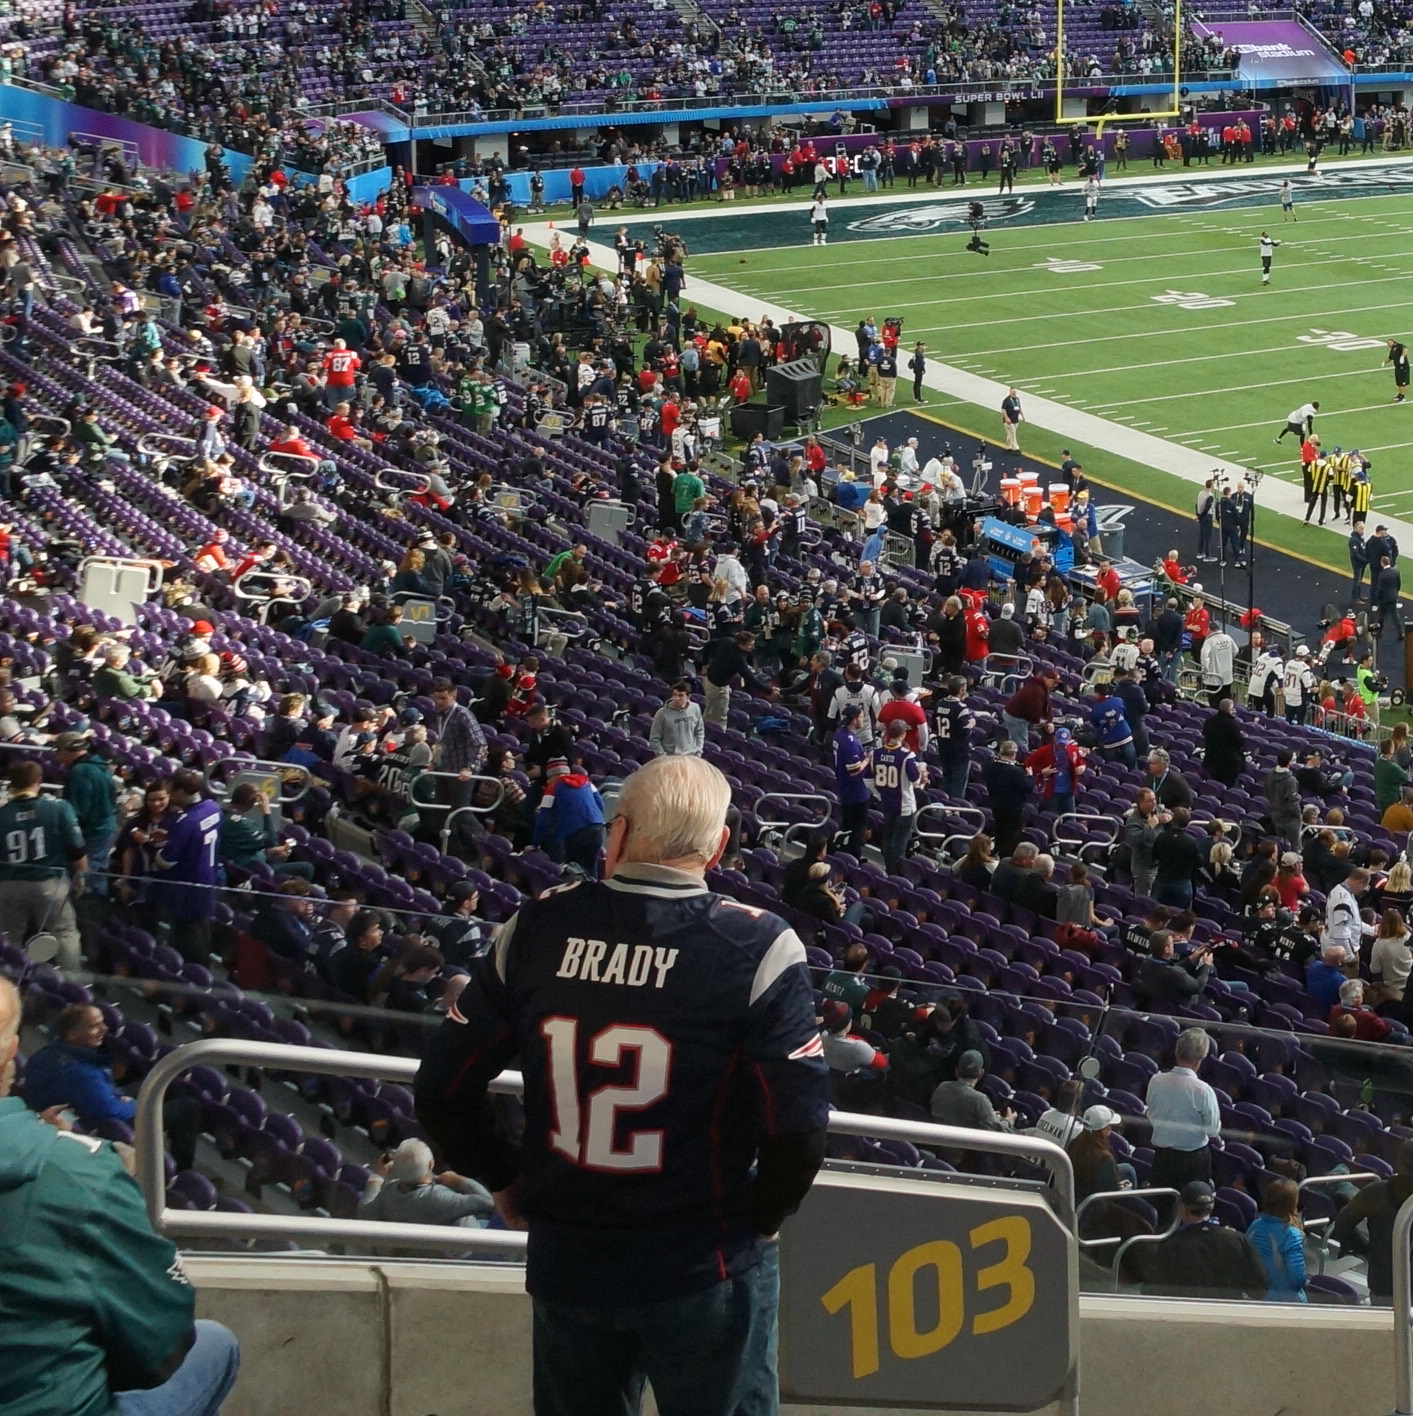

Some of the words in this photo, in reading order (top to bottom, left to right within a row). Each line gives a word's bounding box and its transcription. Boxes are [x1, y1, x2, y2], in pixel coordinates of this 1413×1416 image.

[1258, 49, 1315, 57] stadium
[332, 357, 351, 372] 87
[591, 414, 606, 427] 87
[939, 562, 952, 576] 12
[851, 650, 869, 670] 12
[936, 718, 950, 738] 12
[875, 765, 898, 788] 80
[6, 826, 48, 864] 91
[203, 830, 219, 868] 7
[556, 937, 679, 988] BRADY
[541, 1014, 674, 1173] 12
[821, 1216, 1036, 1380] 103
